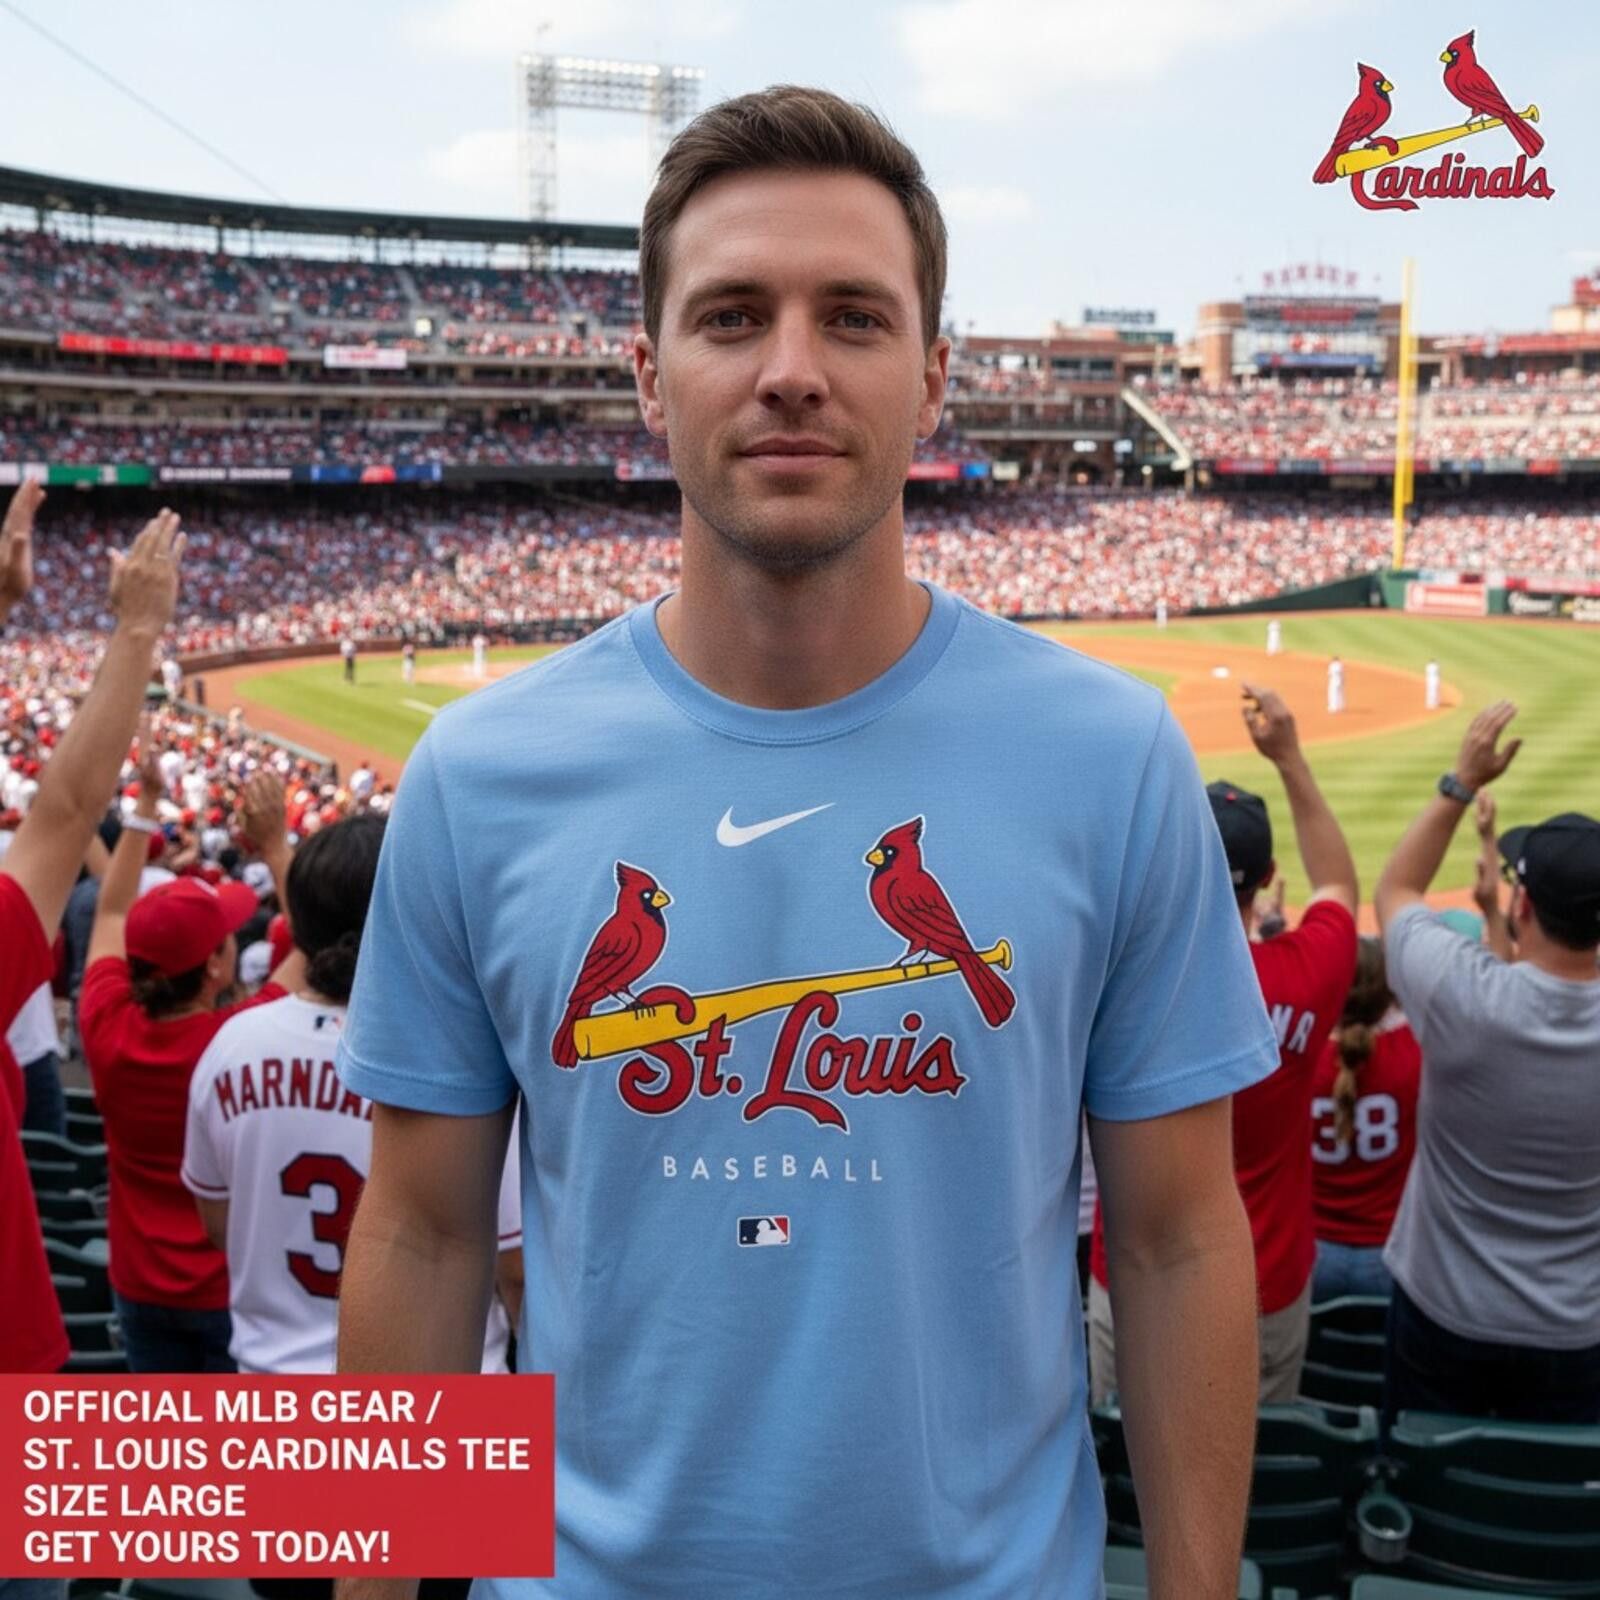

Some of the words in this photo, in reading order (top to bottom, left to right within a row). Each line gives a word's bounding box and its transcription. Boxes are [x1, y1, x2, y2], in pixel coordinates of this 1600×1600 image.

[618, 984, 743, 1117] St.
[742, 990, 968, 1134] Louis
[1311, 1094, 1398, 1164] 38
[663, 1154, 883, 1182] BASEBALL
